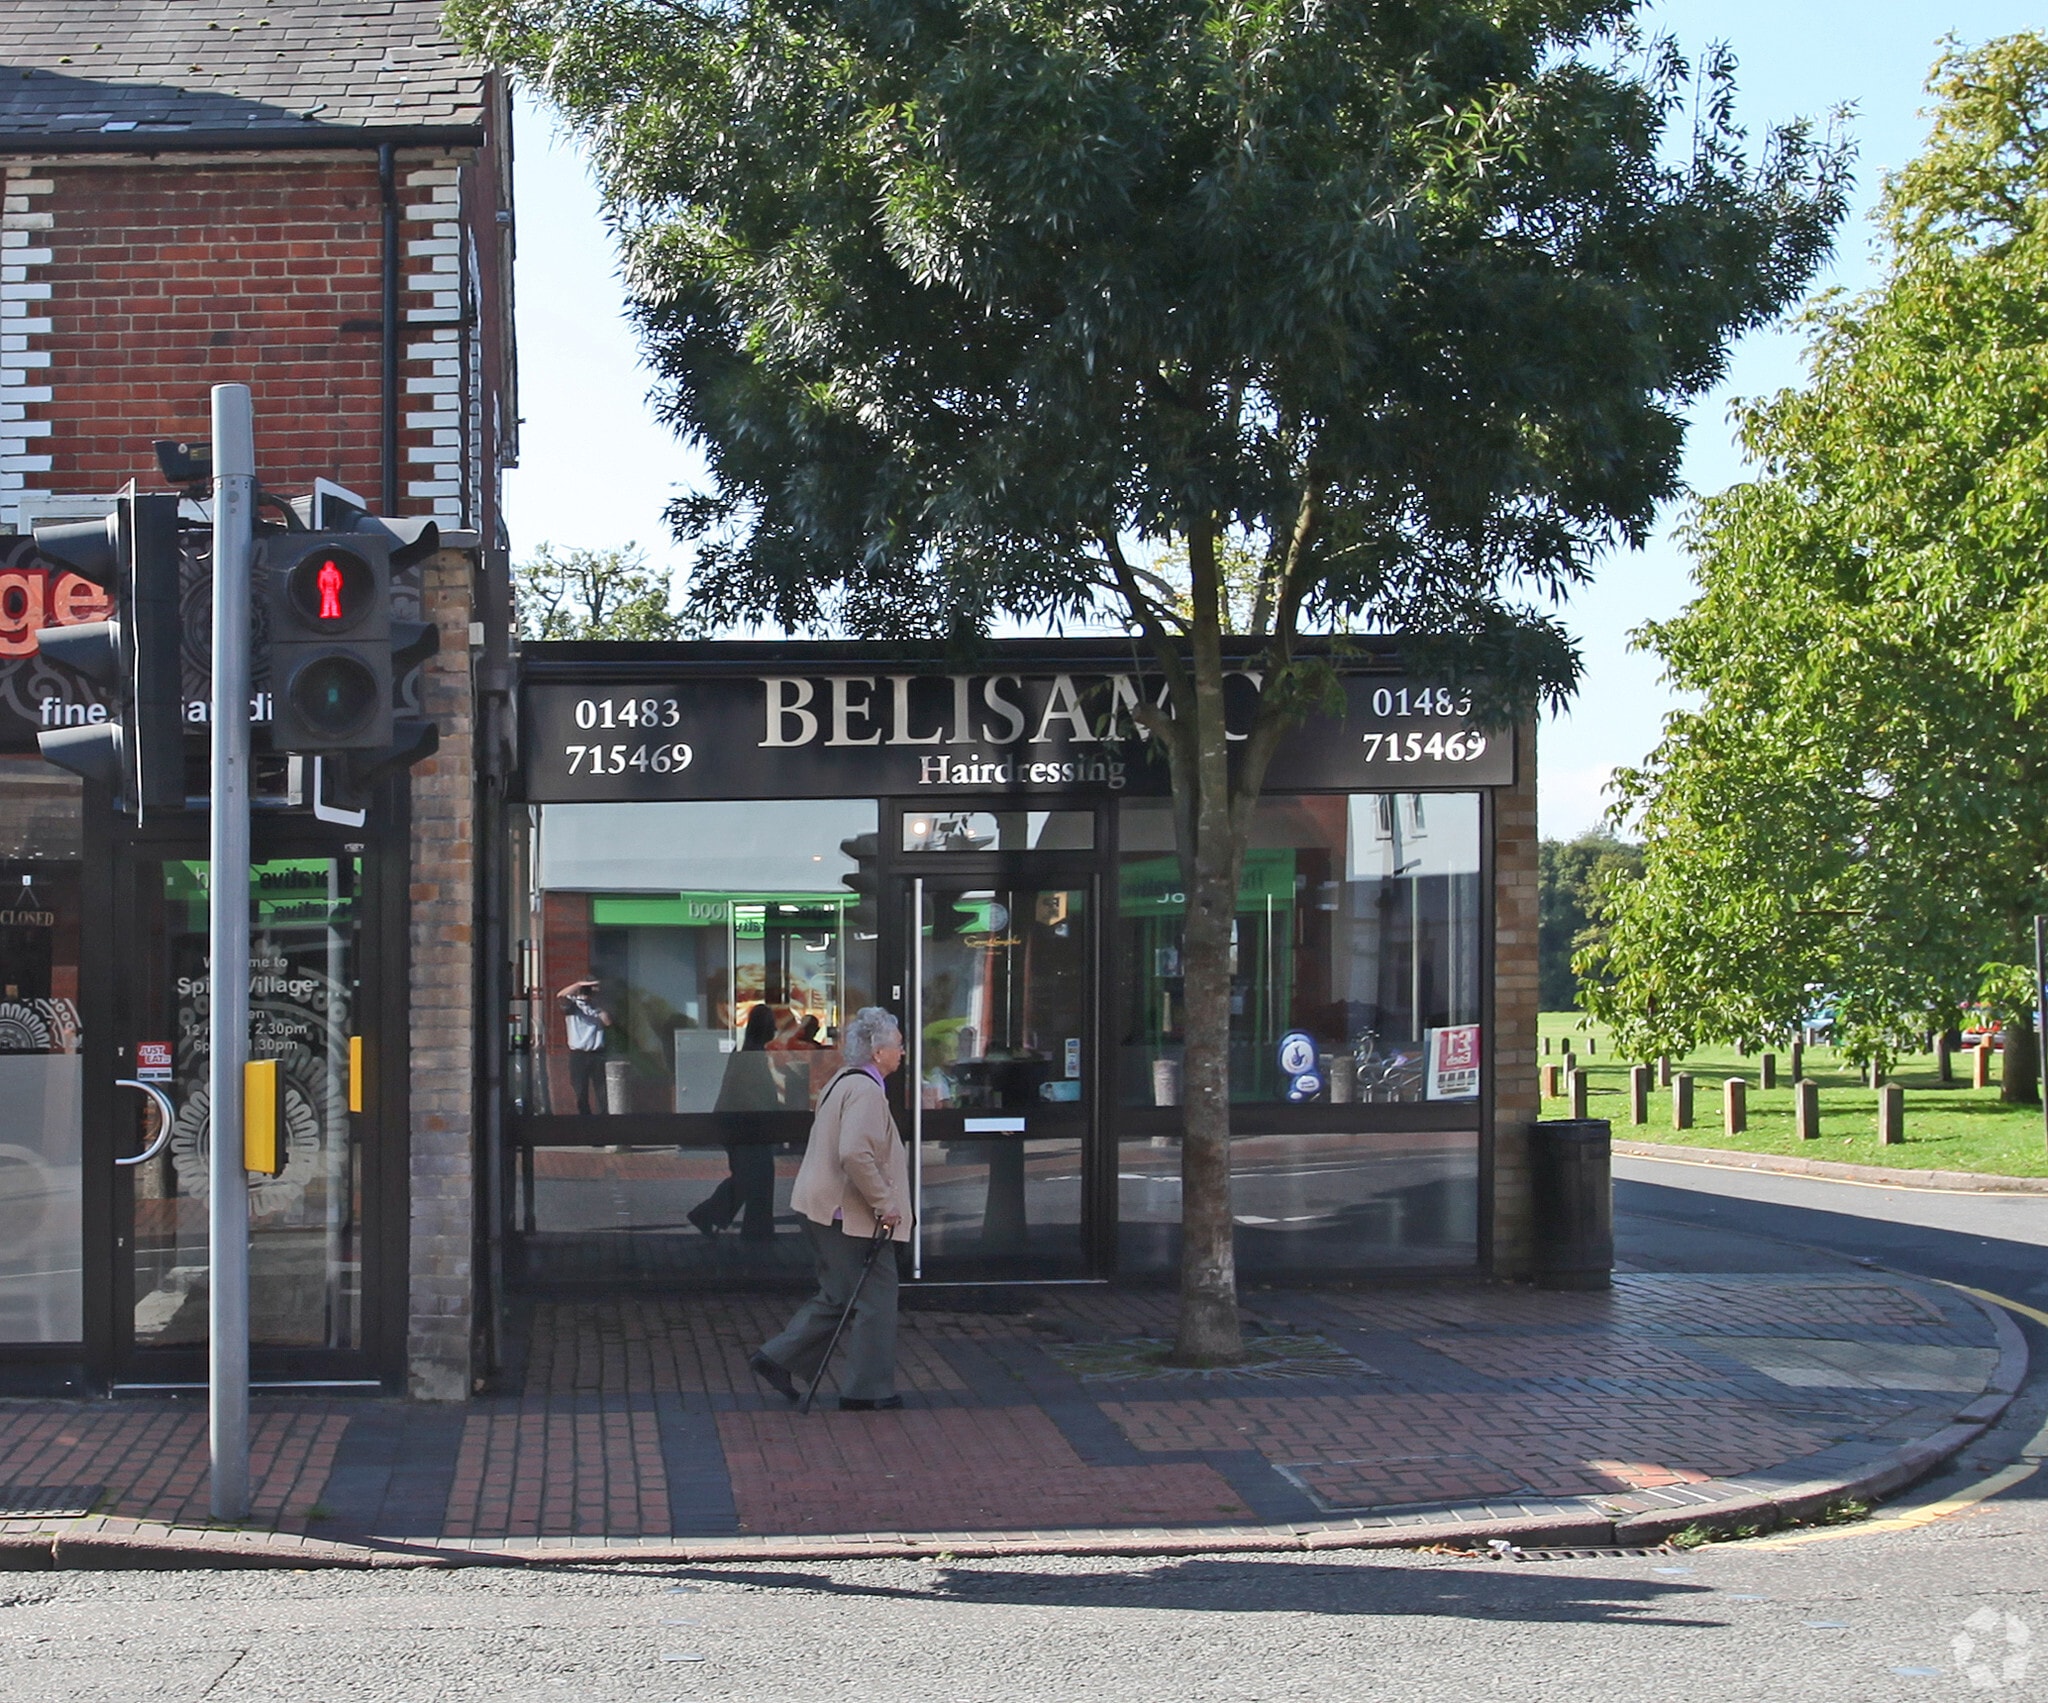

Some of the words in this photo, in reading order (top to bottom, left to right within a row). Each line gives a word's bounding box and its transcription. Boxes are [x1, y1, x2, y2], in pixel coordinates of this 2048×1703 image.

[40, 697, 107, 725] fine
[575, 699, 681, 729] 01483
[1372, 687, 1472, 716] 01483
[566, 743, 693, 774] 715469
[1363, 731, 1486, 762] 715469
[918, 754, 1126, 789] Hairdressing
[273, 957, 288, 968] to
[177, 977, 210, 998] Spi
[185, 1025, 200, 1036] 12
[255, 1023, 307, 1036] 2.30pm
[140, 1046, 165, 1055] JUST
[146, 1055, 164, 1063] EAT
